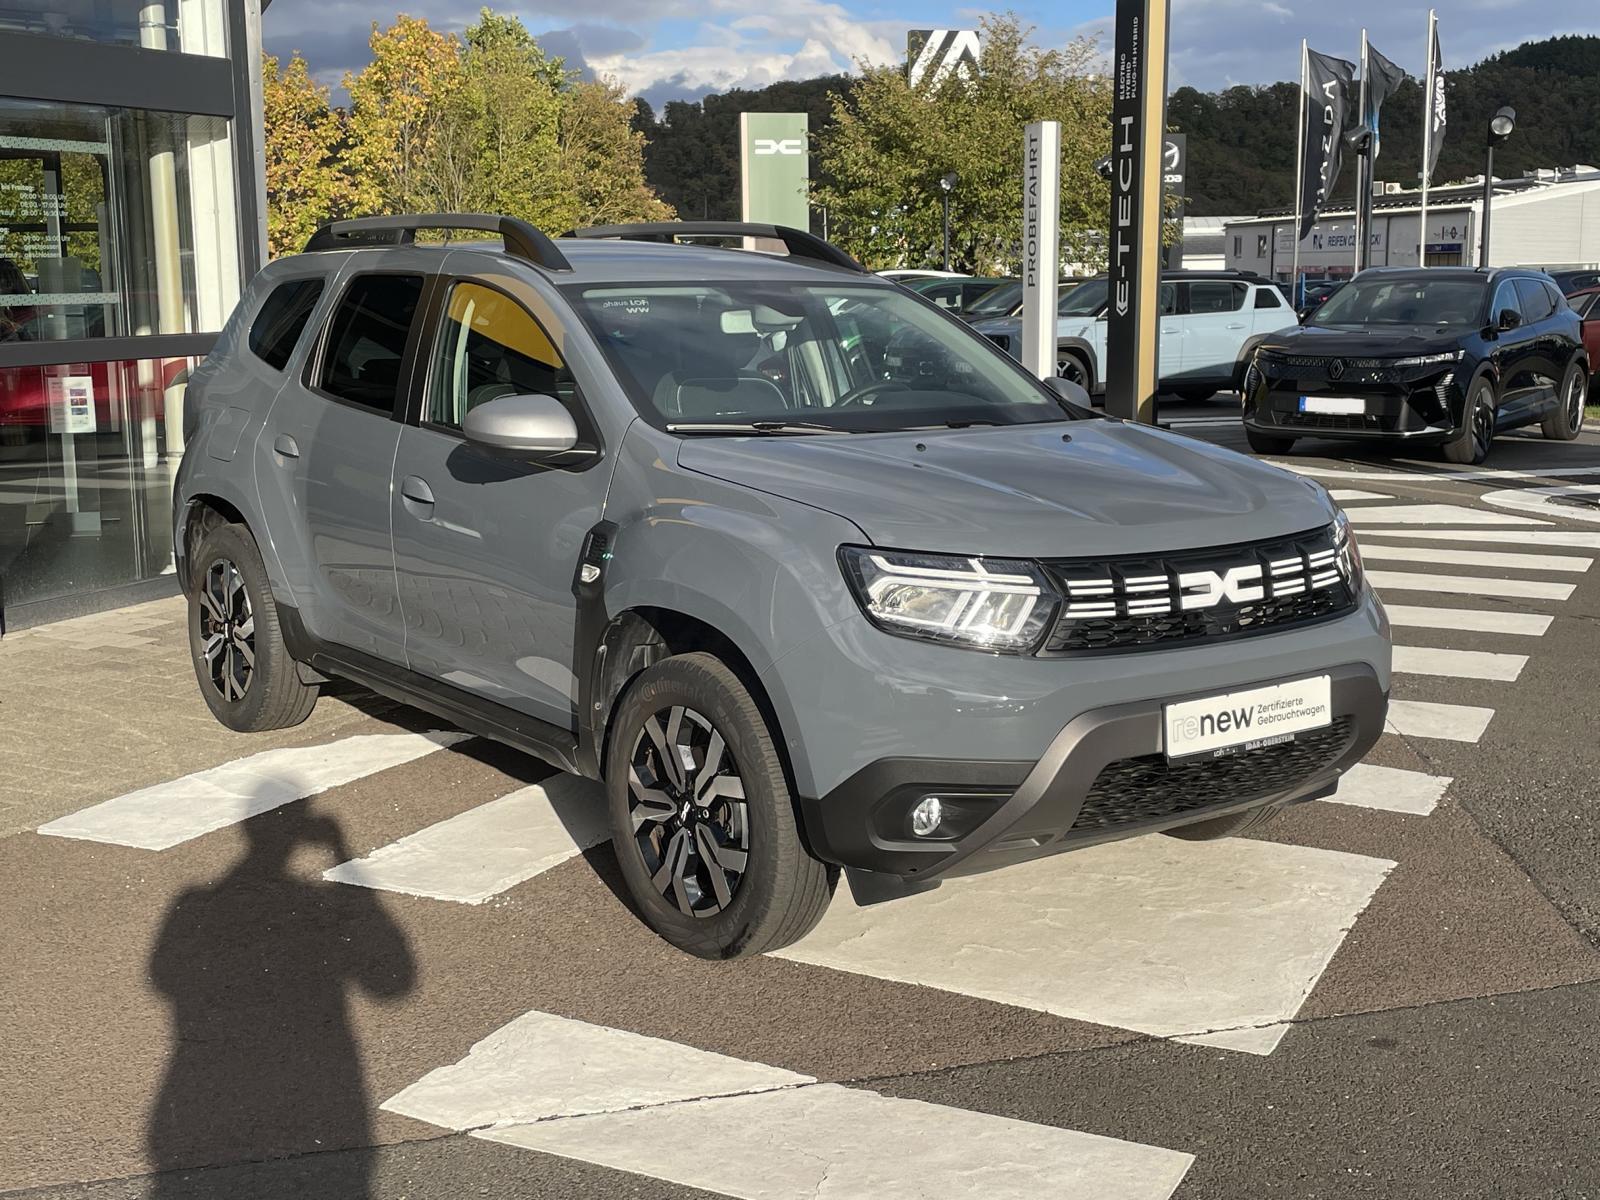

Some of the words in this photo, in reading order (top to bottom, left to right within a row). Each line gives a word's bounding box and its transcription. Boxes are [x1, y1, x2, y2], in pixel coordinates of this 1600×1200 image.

[1028, 133, 1038, 288] PROBEFAHRT
[1116, 115, 1134, 317] E-TECH
[1328, 235, 1347, 247] REIFEN
[1257, 697, 1304, 714] Zertifizierte
[1257, 705, 1326, 726] Gebrauchtwagen
[1172, 706, 1254, 743] renew
